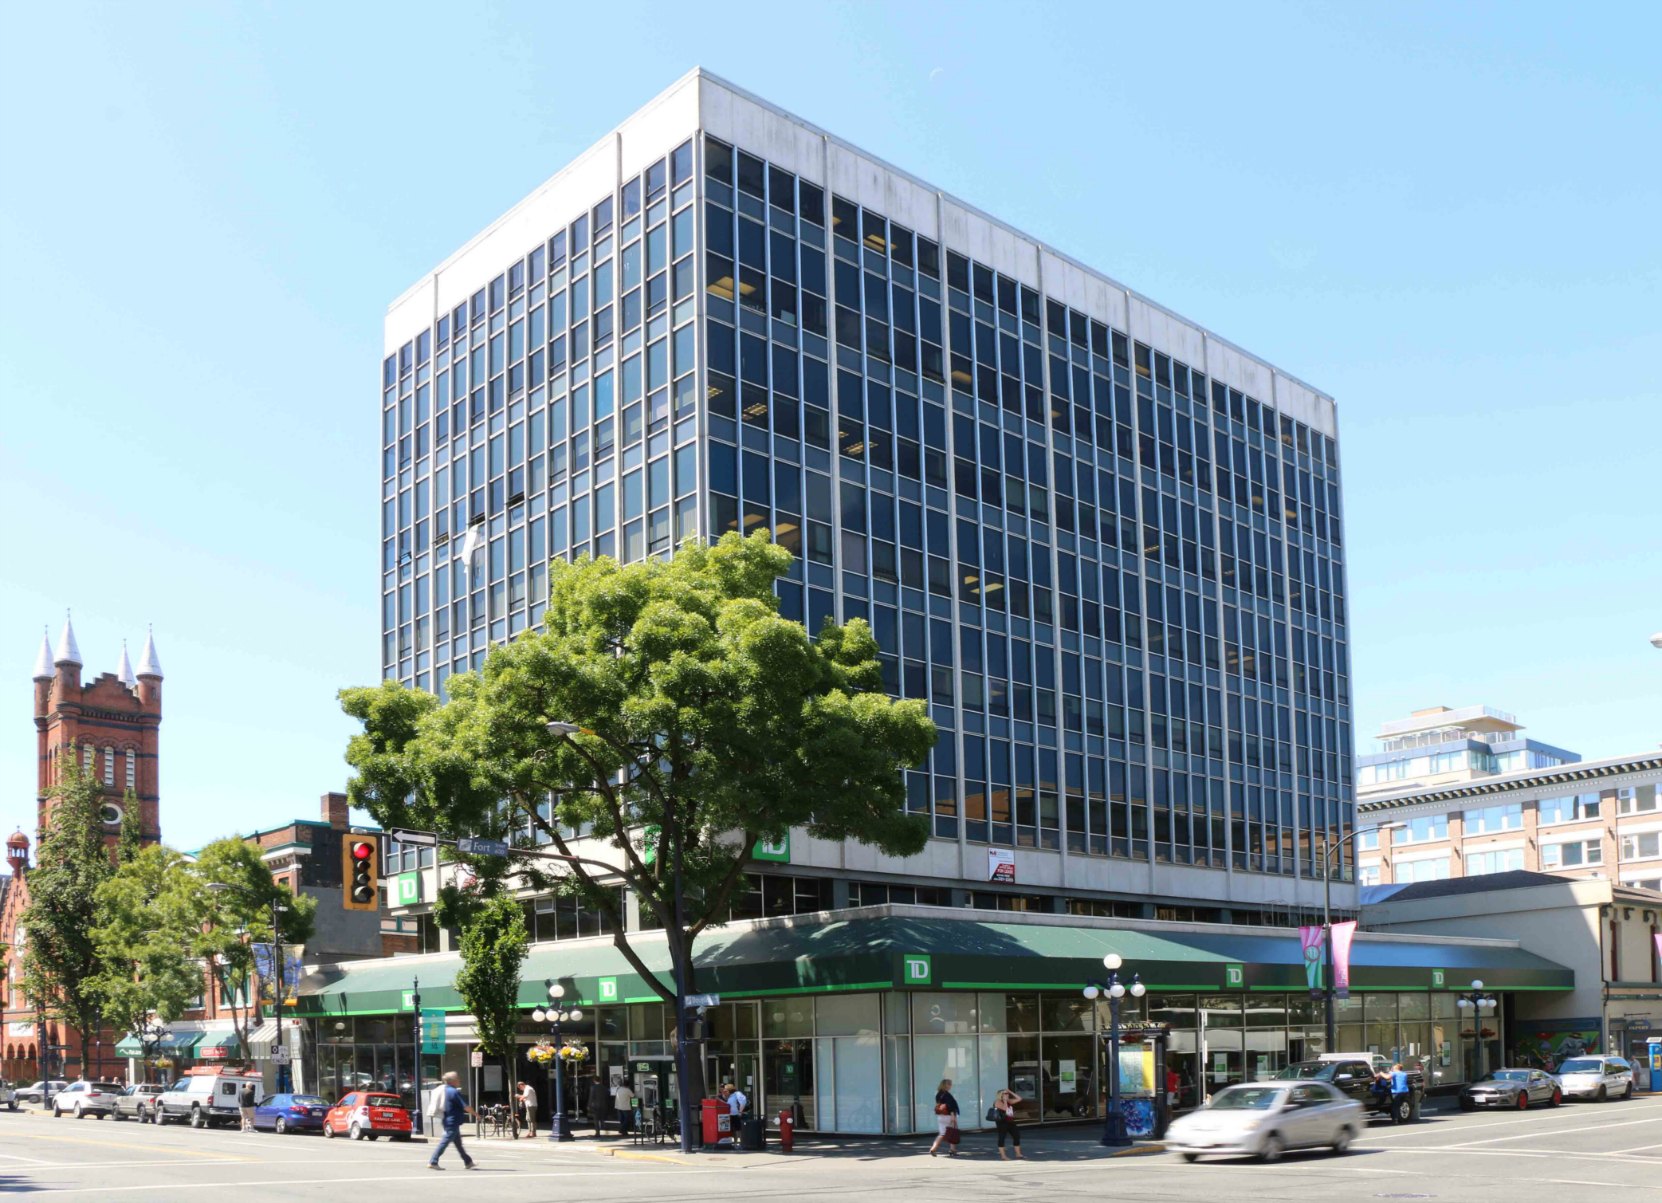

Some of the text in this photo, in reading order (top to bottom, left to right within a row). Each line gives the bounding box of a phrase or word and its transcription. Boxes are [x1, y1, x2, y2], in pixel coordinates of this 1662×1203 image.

[474, 842, 490, 852] Fort
[400, 879, 416, 899] TD
[906, 960, 929, 979] TD
[1227, 968, 1242, 983] TD
[1433, 972, 1444, 984] TD
[599, 982, 616, 997] TD
